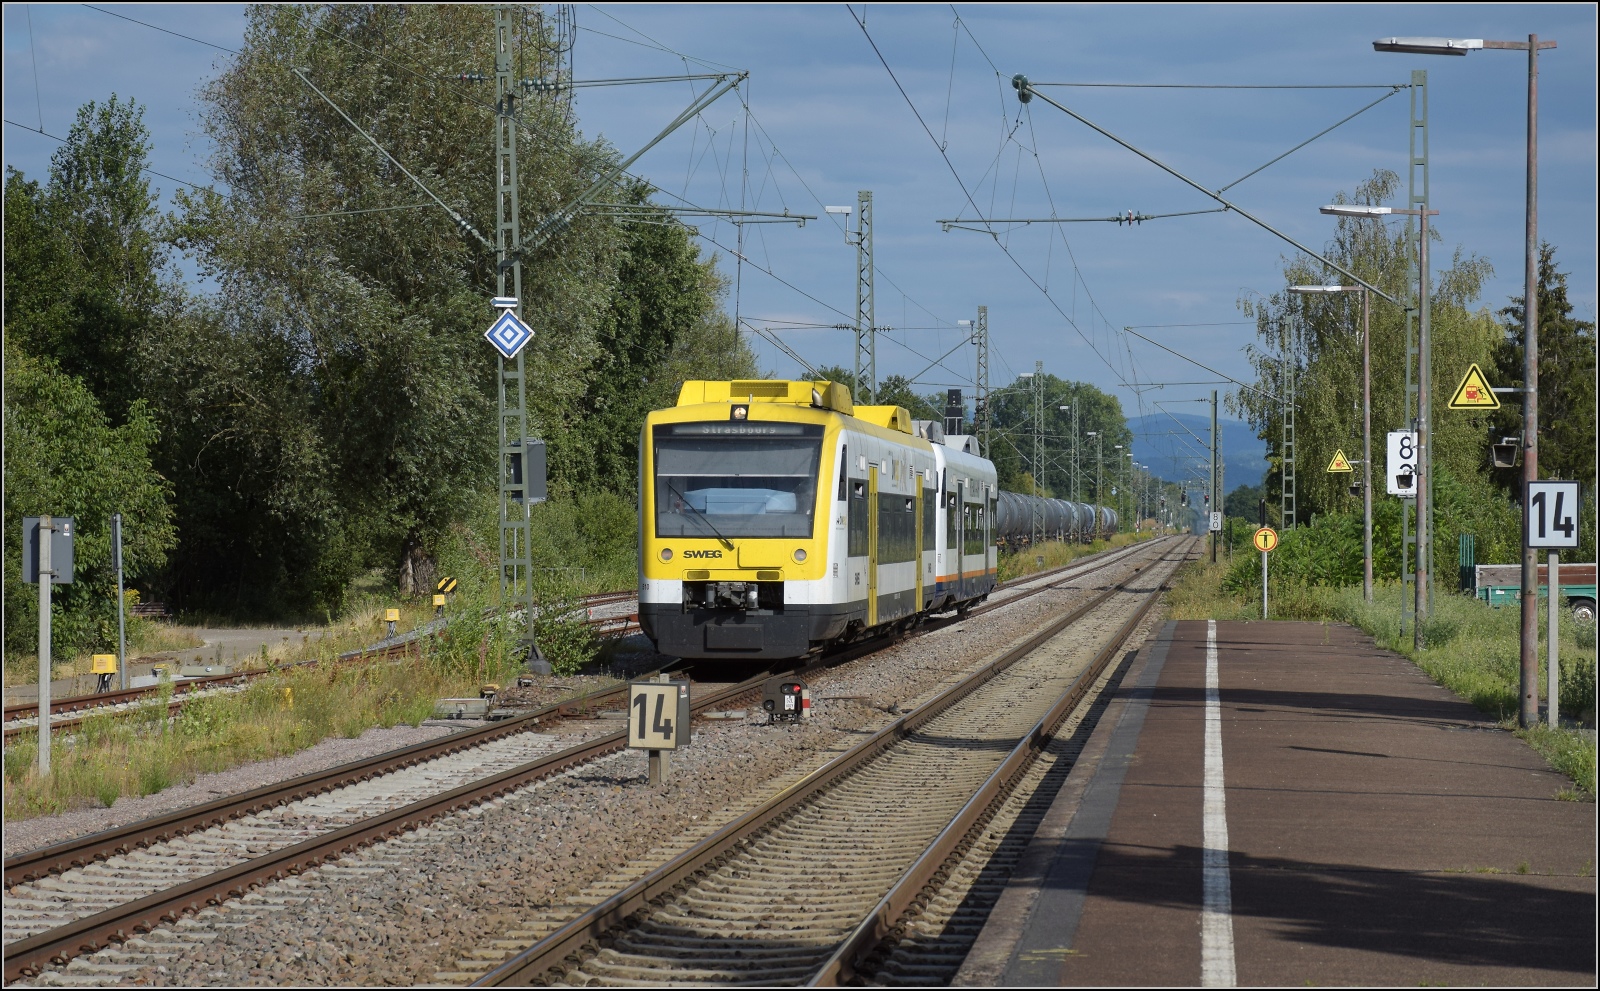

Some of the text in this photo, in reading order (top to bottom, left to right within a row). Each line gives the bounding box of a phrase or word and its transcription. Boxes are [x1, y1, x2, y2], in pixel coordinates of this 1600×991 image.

[1399, 436, 1414, 460] 8
[1531, 491, 1575, 539] 14
[682, 550, 723, 559] SWEG
[633, 693, 674, 740] 14
